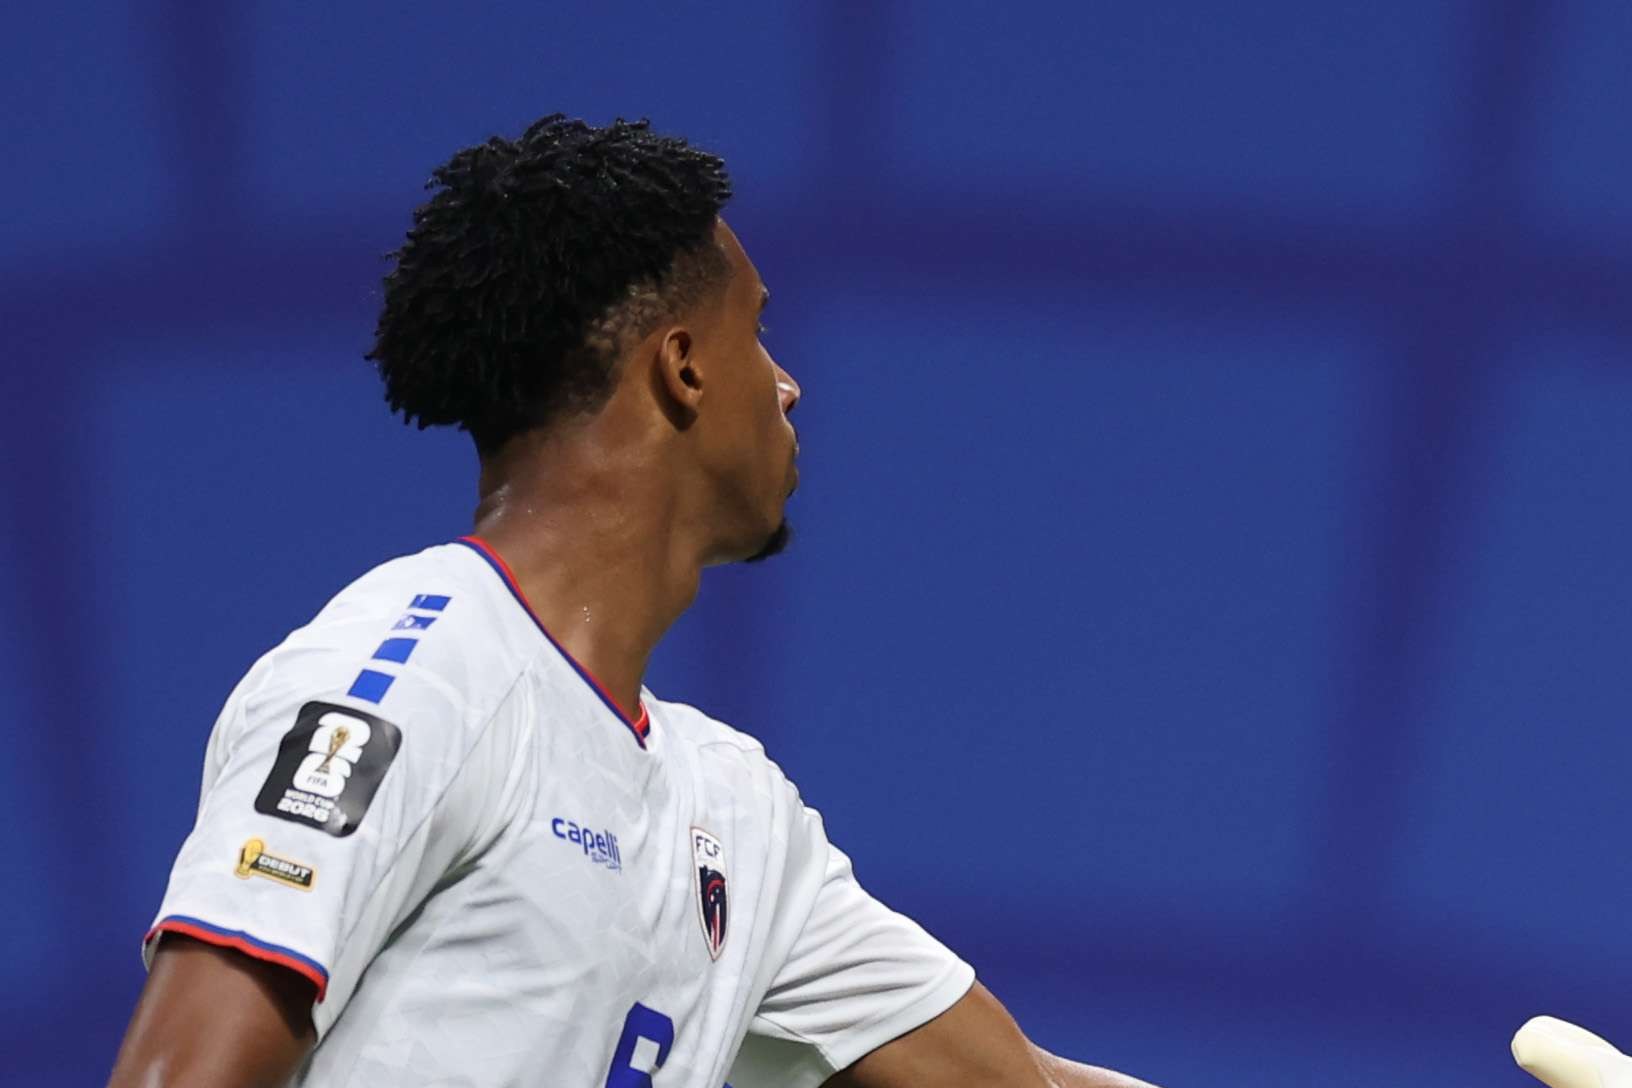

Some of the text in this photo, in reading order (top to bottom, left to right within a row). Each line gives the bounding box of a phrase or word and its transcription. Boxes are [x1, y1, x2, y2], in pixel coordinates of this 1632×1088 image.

[306, 775, 328, 788] FIFA
[277, 797, 330, 823] 2026
[551, 817, 621, 865] capelli
[695, 835, 720, 857] FCF
[258, 854, 310, 878] DEBUT
